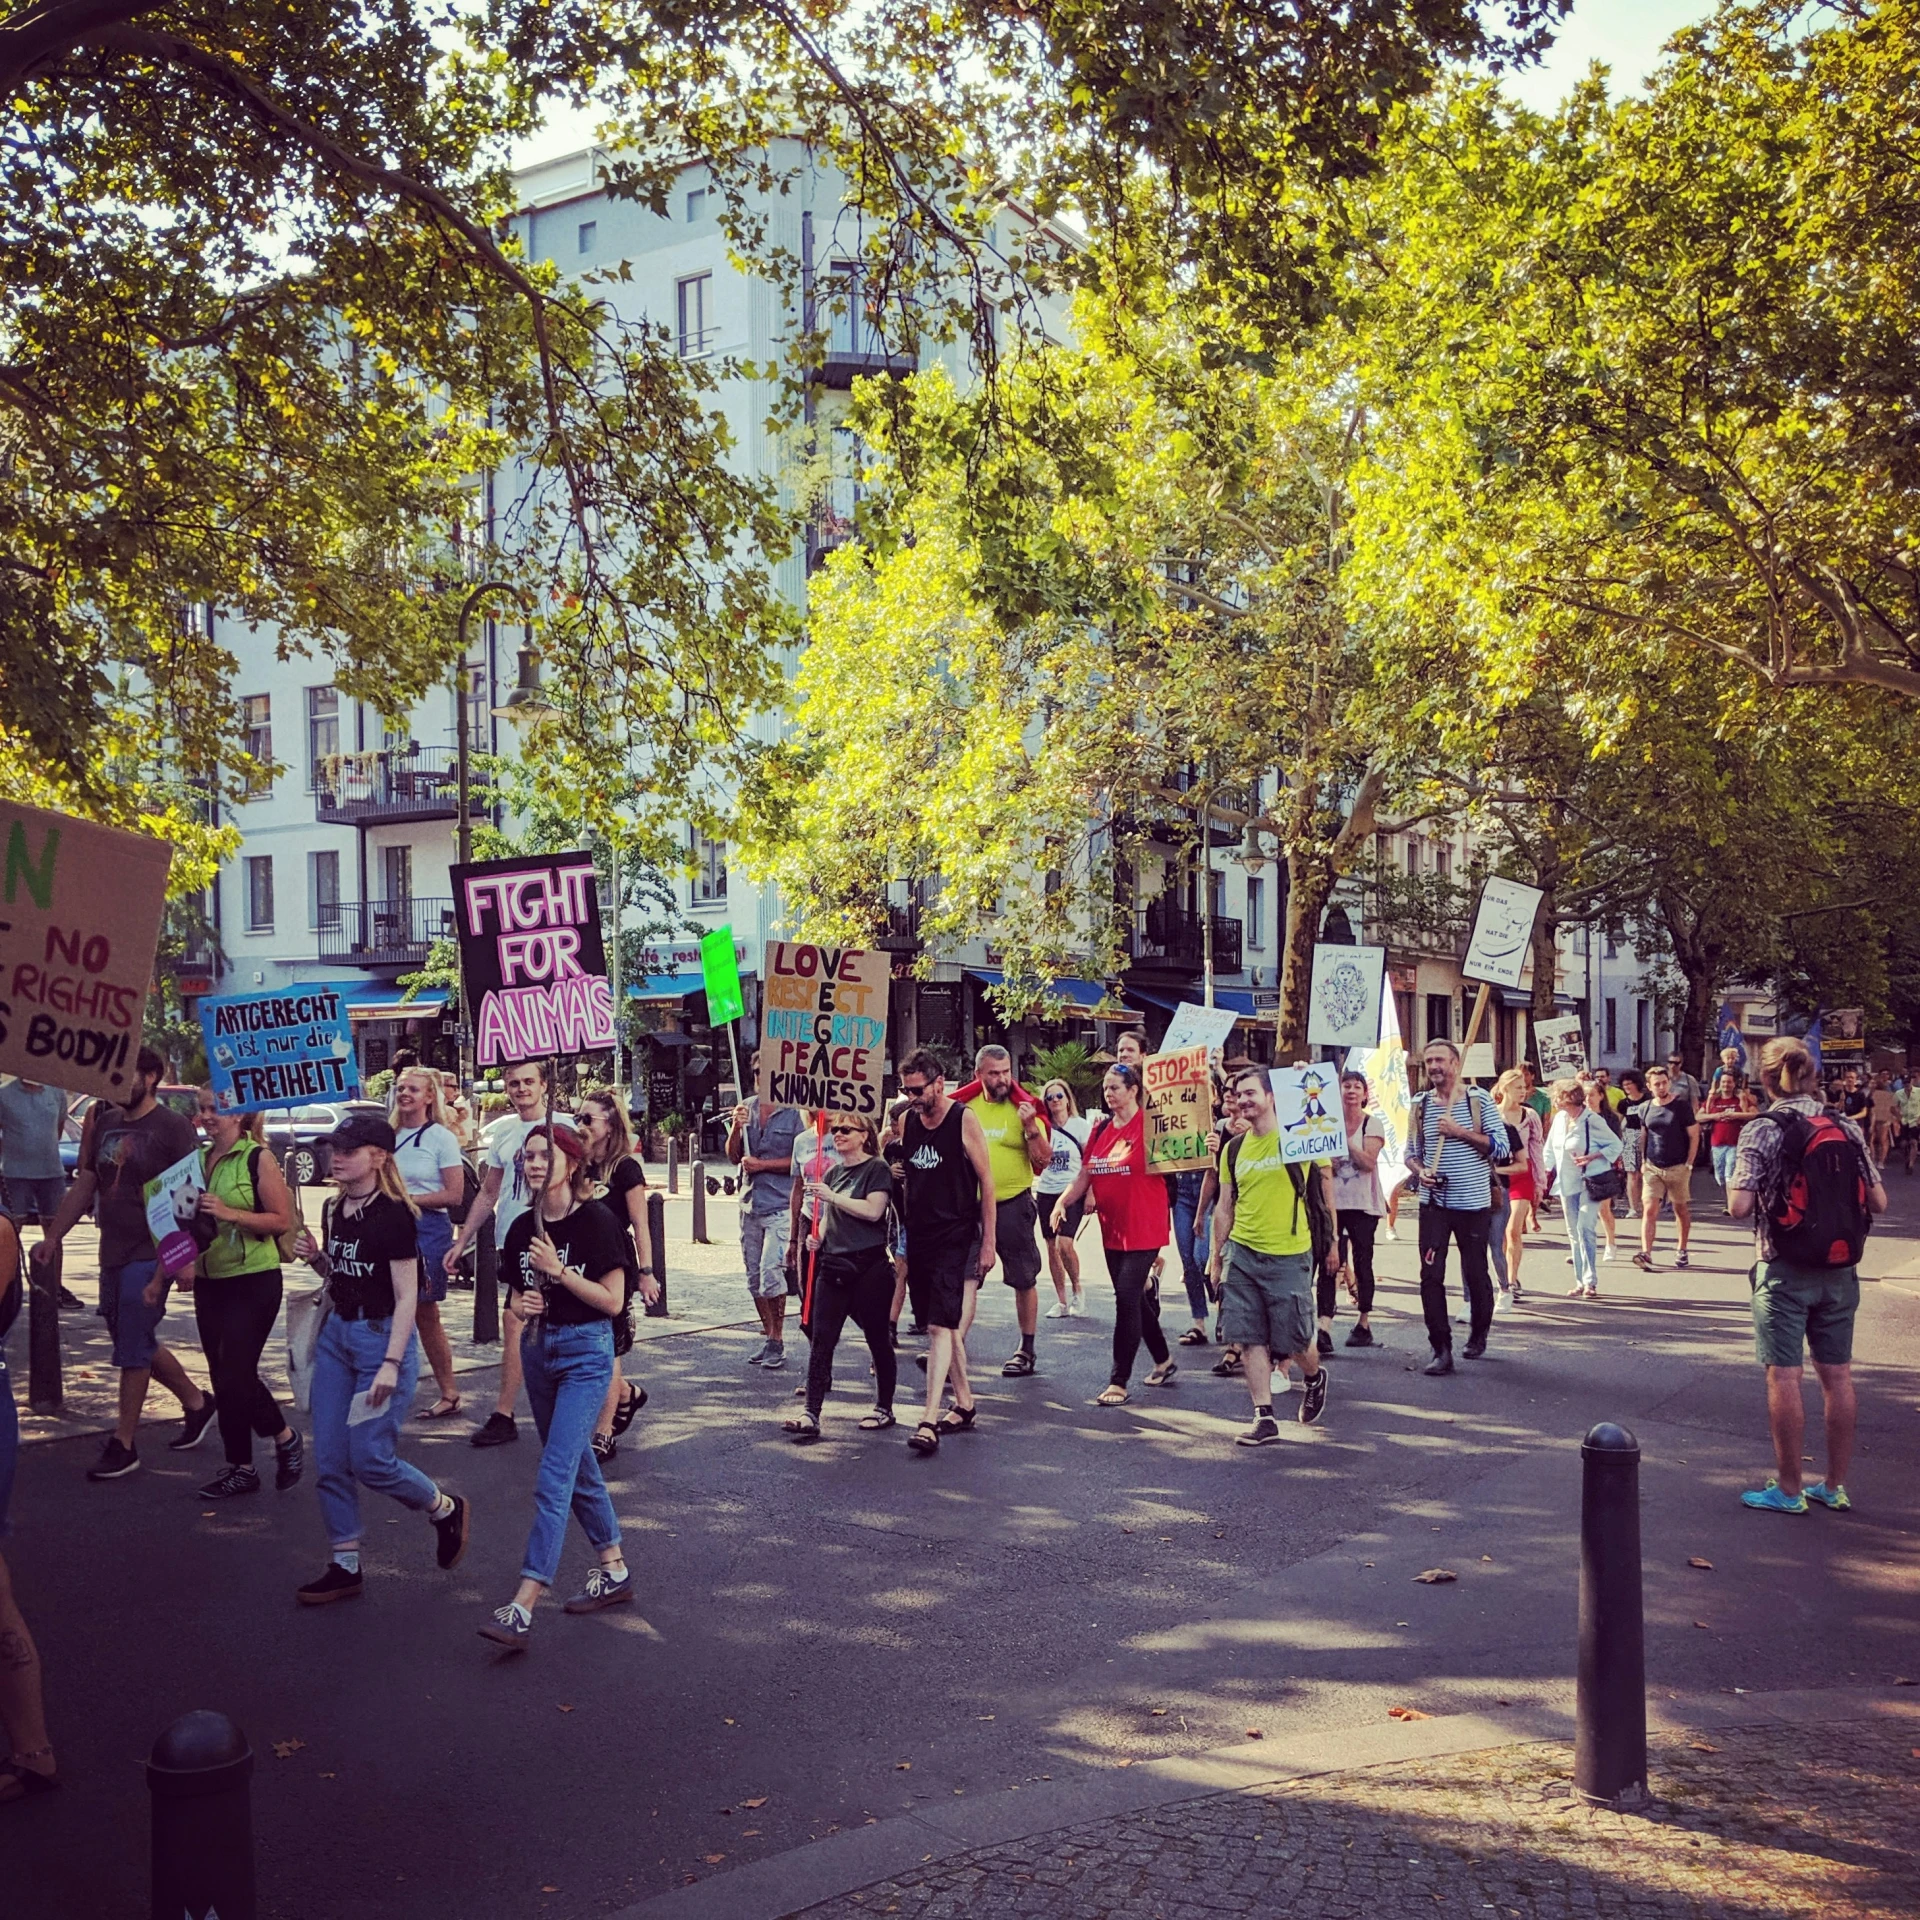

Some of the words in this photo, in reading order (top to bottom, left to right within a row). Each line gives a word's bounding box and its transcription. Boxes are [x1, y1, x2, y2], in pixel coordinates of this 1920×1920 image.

[464, 864, 595, 936] FIGHT
[45, 925, 110, 974] NO
[497, 926, 585, 986] FOR
[774, 942, 864, 983] LOVE
[11, 963, 138, 1028] RIGHTS
[214, 992, 341, 1037] ARTGERECHT
[767, 975, 873, 1015] RESPECT
[237, 1031, 258, 1058] ist
[266, 1029, 299, 1053] nur
[305, 1023, 334, 1046] die
[477, 974, 618, 1066] ANIMALS
[767, 1009, 884, 1049] INTEGRITY
[230, 1056, 348, 1105] FREIHEIT
[780, 1040, 870, 1082] PEACE
[770, 1070, 875, 1114] KINDNESS
[1180, 1087, 1198, 1104] die
[1151, 1114, 1188, 1135] TIERE
[1148, 1131, 1209, 1165] LEBEN
